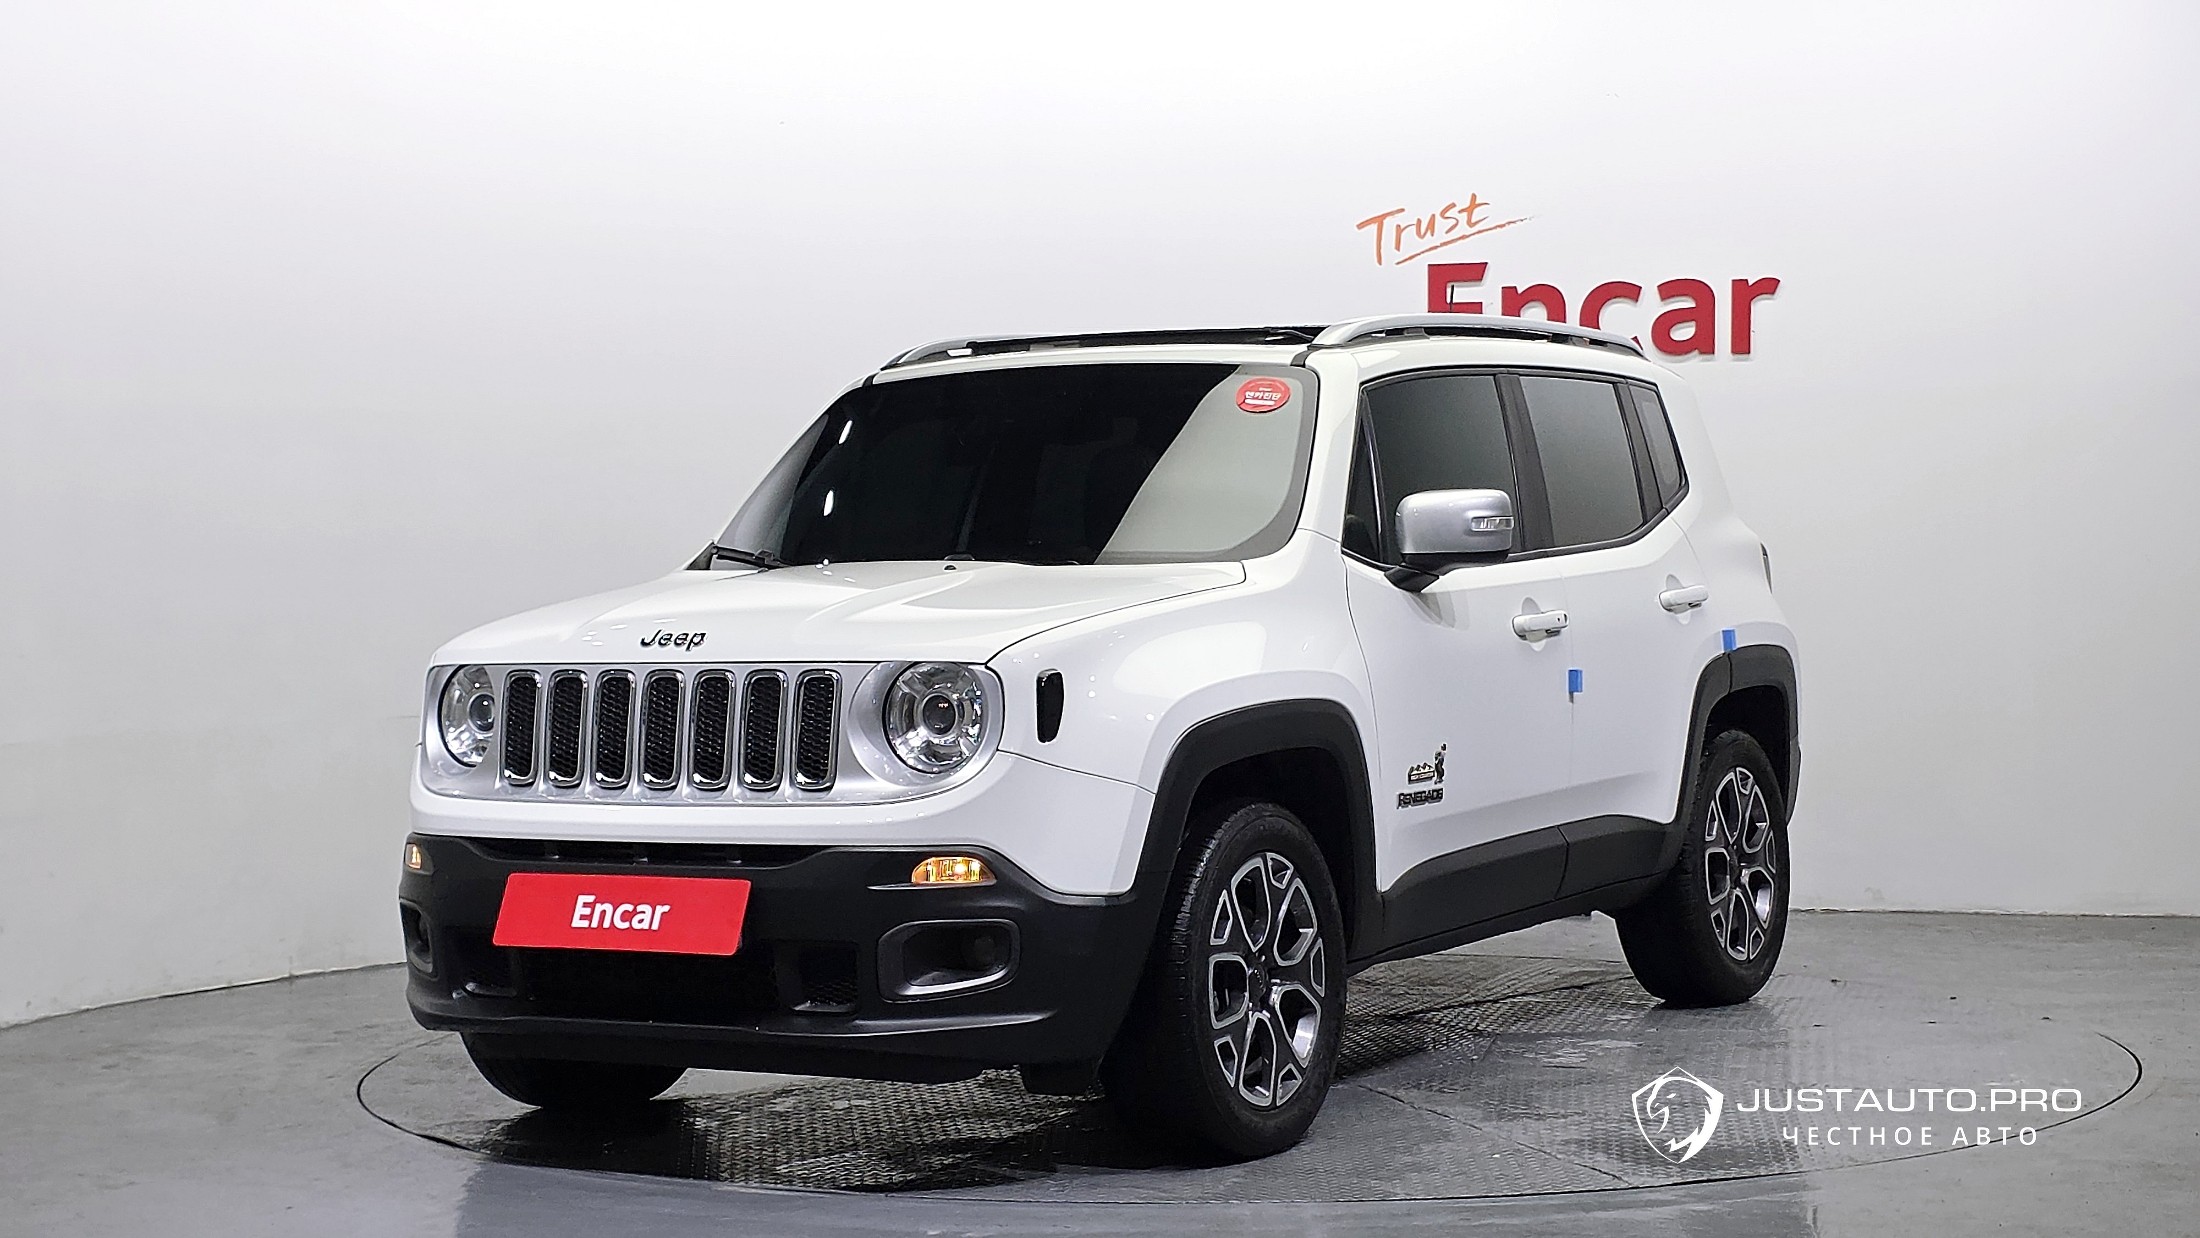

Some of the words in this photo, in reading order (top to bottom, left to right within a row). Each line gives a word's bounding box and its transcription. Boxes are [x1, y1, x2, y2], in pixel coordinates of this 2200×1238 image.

[1357, 193, 1490, 266] Trust
[1427, 261, 1781, 357] Encar
[640, 629, 707, 652] Jeep
[1396, 787, 1444, 810] RENEGADE
[570, 894, 671, 931] Encar
